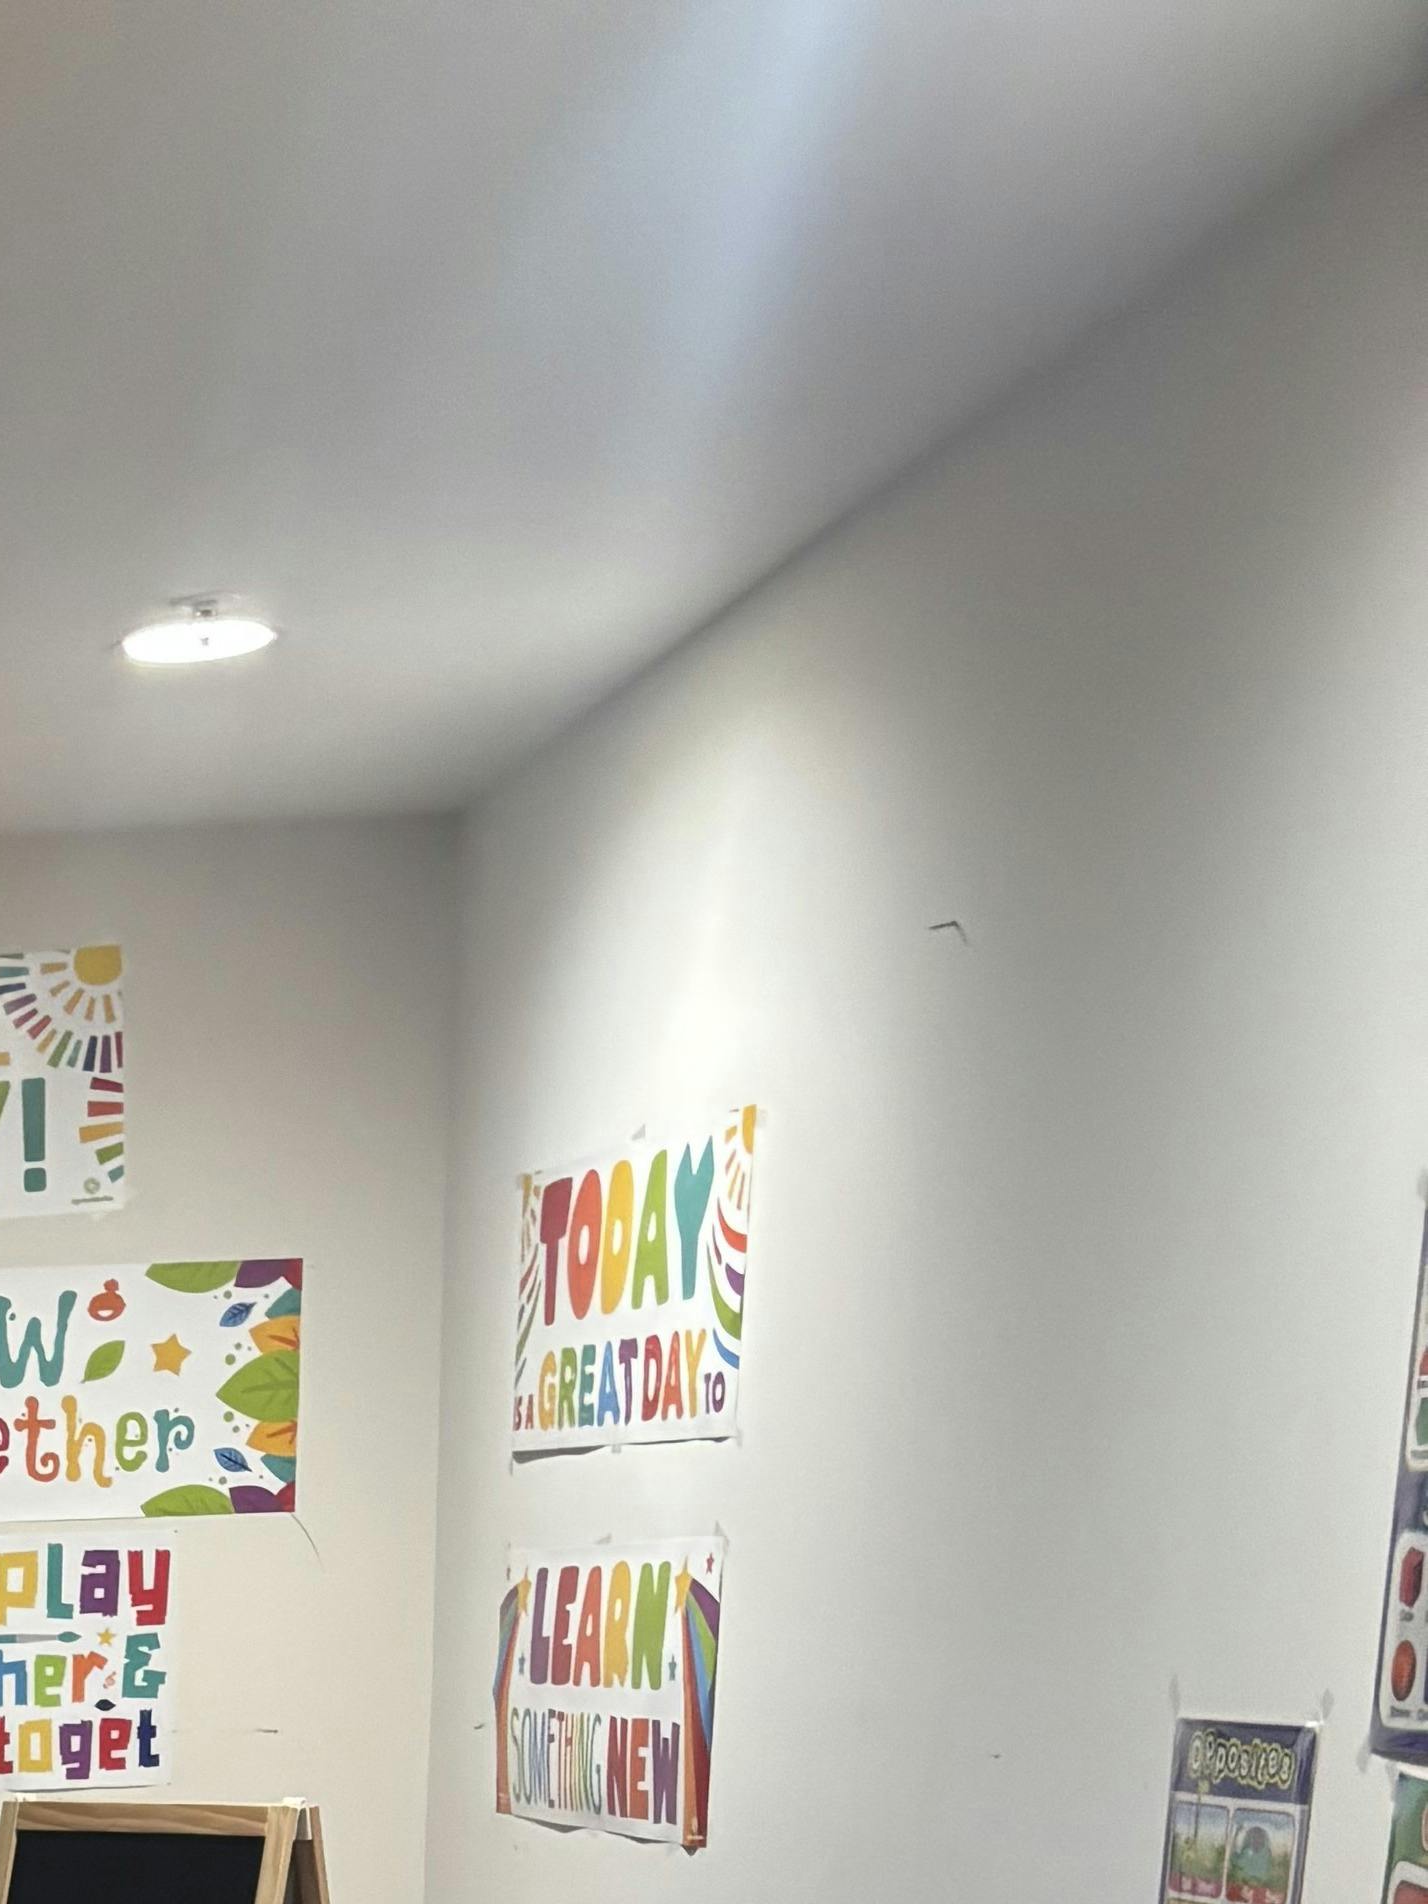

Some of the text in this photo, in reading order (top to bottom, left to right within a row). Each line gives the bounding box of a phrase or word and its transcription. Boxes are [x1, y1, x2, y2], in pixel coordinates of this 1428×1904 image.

[540, 1134, 715, 1326] TODAY
[525, 1393, 535, 1430] A
[538, 1338, 638, 1431] GREAT
[641, 1328, 707, 1421] DAY
[704, 1370, 726, 1415] TO
[530, 1560, 671, 1690] LEARN
[511, 1708, 681, 1826] SOMETHING NEW
